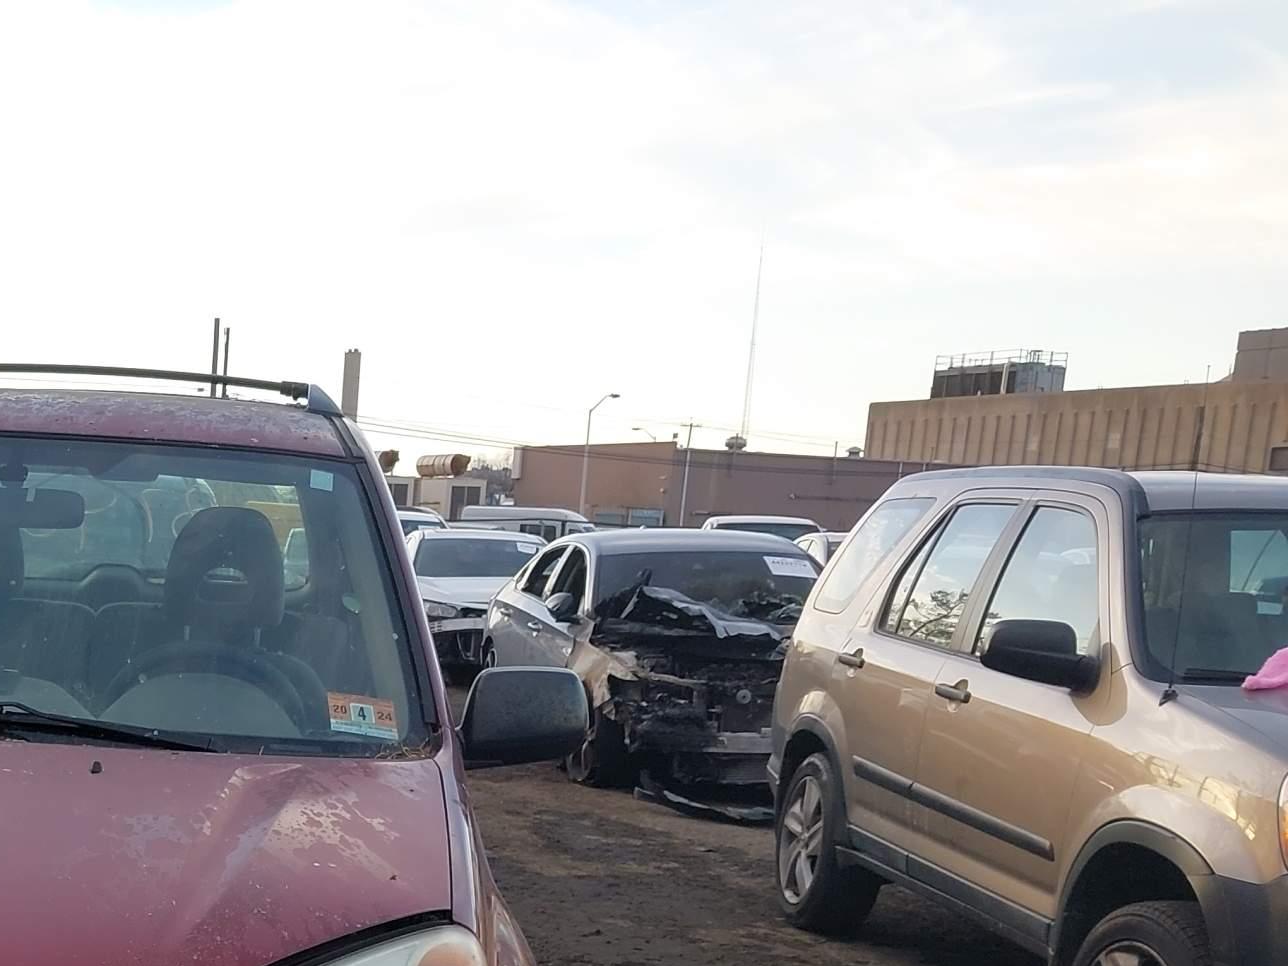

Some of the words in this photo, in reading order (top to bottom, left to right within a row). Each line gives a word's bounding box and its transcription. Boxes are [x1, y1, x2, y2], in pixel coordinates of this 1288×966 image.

[332, 704, 348, 715] 20
[357, 706, 367, 721] 4
[377, 711, 393, 722] 24
